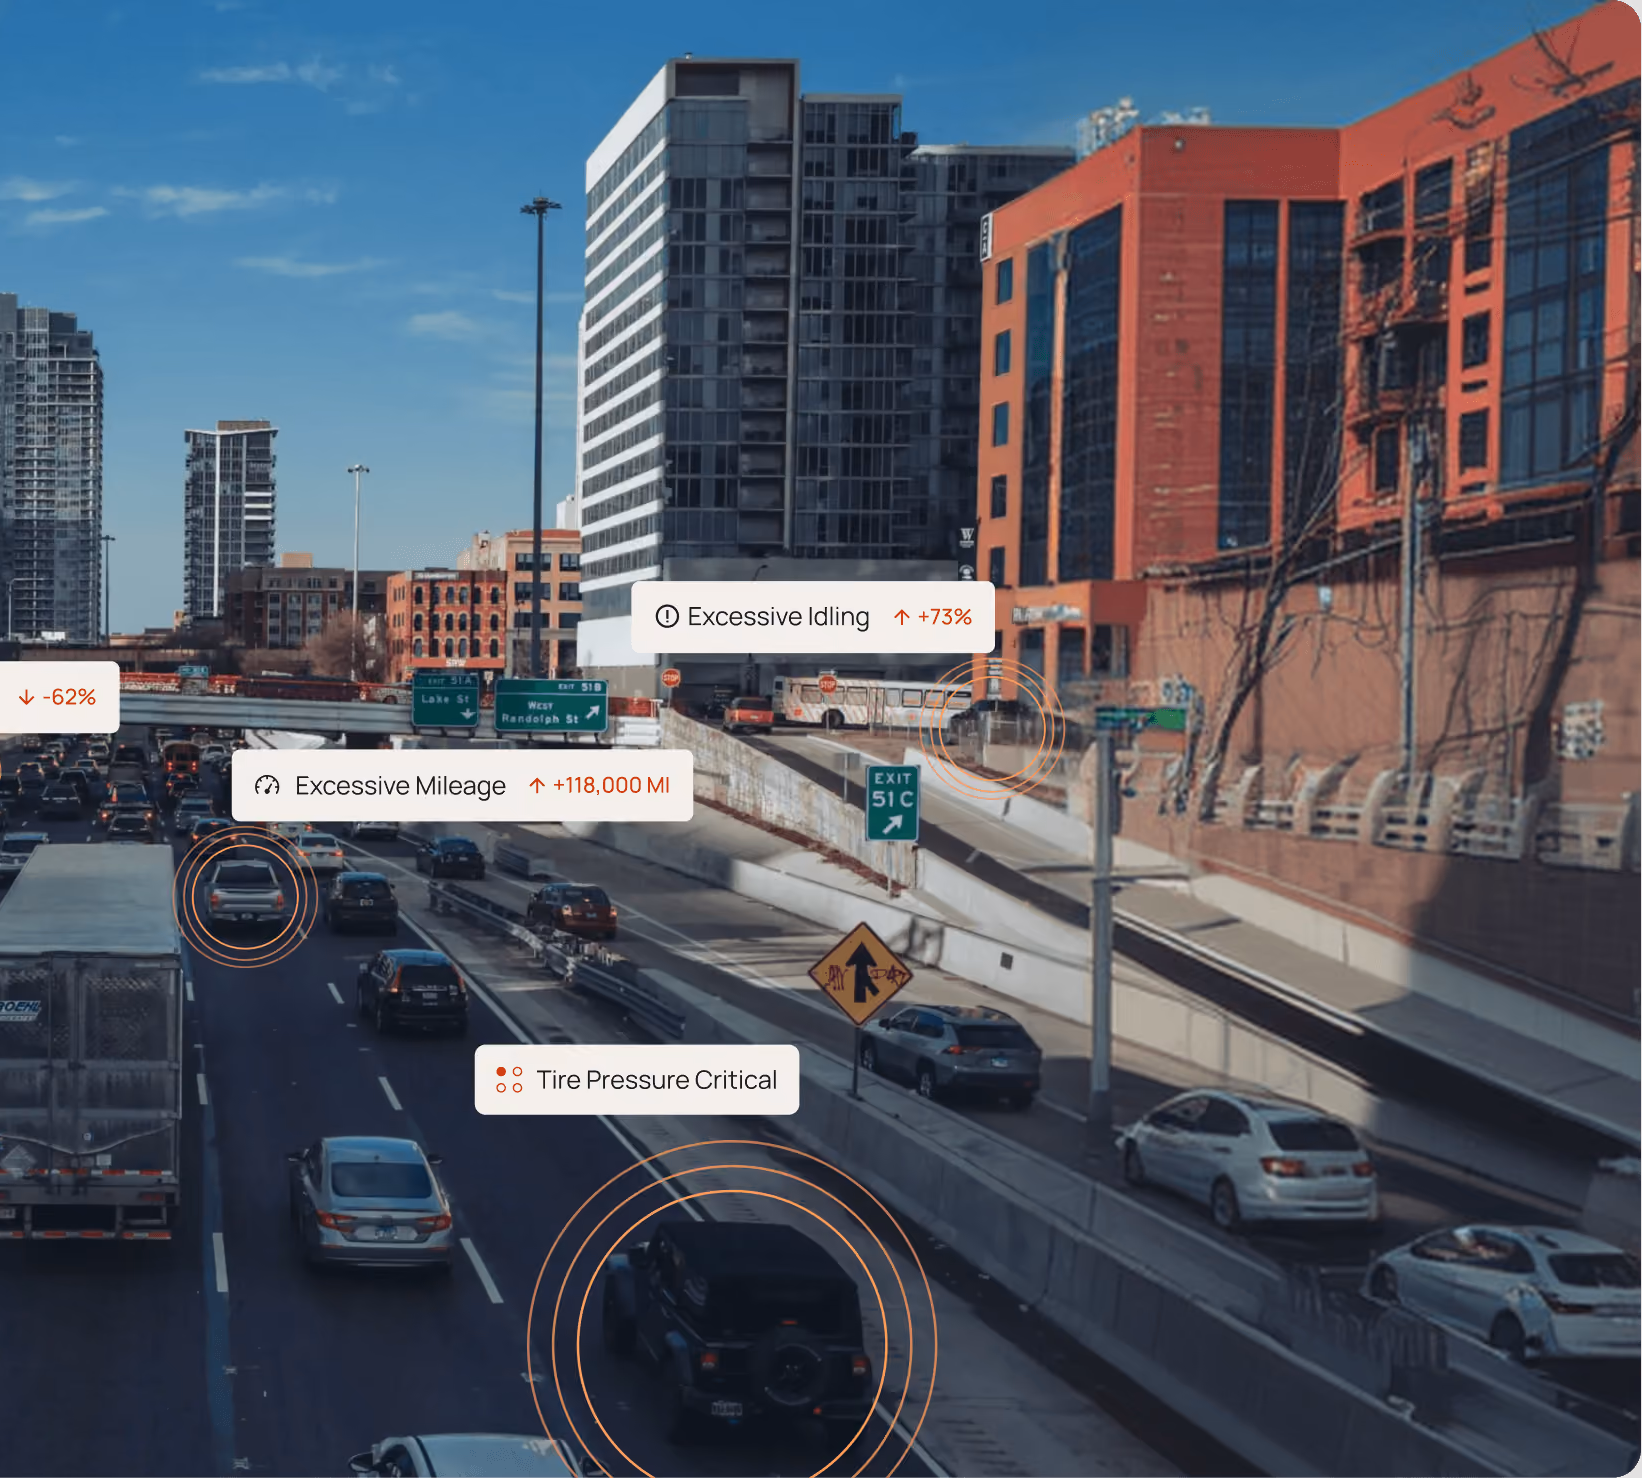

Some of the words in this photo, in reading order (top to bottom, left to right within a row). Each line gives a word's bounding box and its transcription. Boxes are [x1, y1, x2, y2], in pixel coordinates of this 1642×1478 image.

[662, 674, 679, 682] STOP
[581, 682, 602, 692] 51B
[820, 680, 836, 688] STOP
[421, 694, 450, 704] Lake
[456, 694, 470, 704] St
[502, 713, 560, 725] Randolph
[565, 714, 579, 724] St
[874, 772, 912, 784] EXIT
